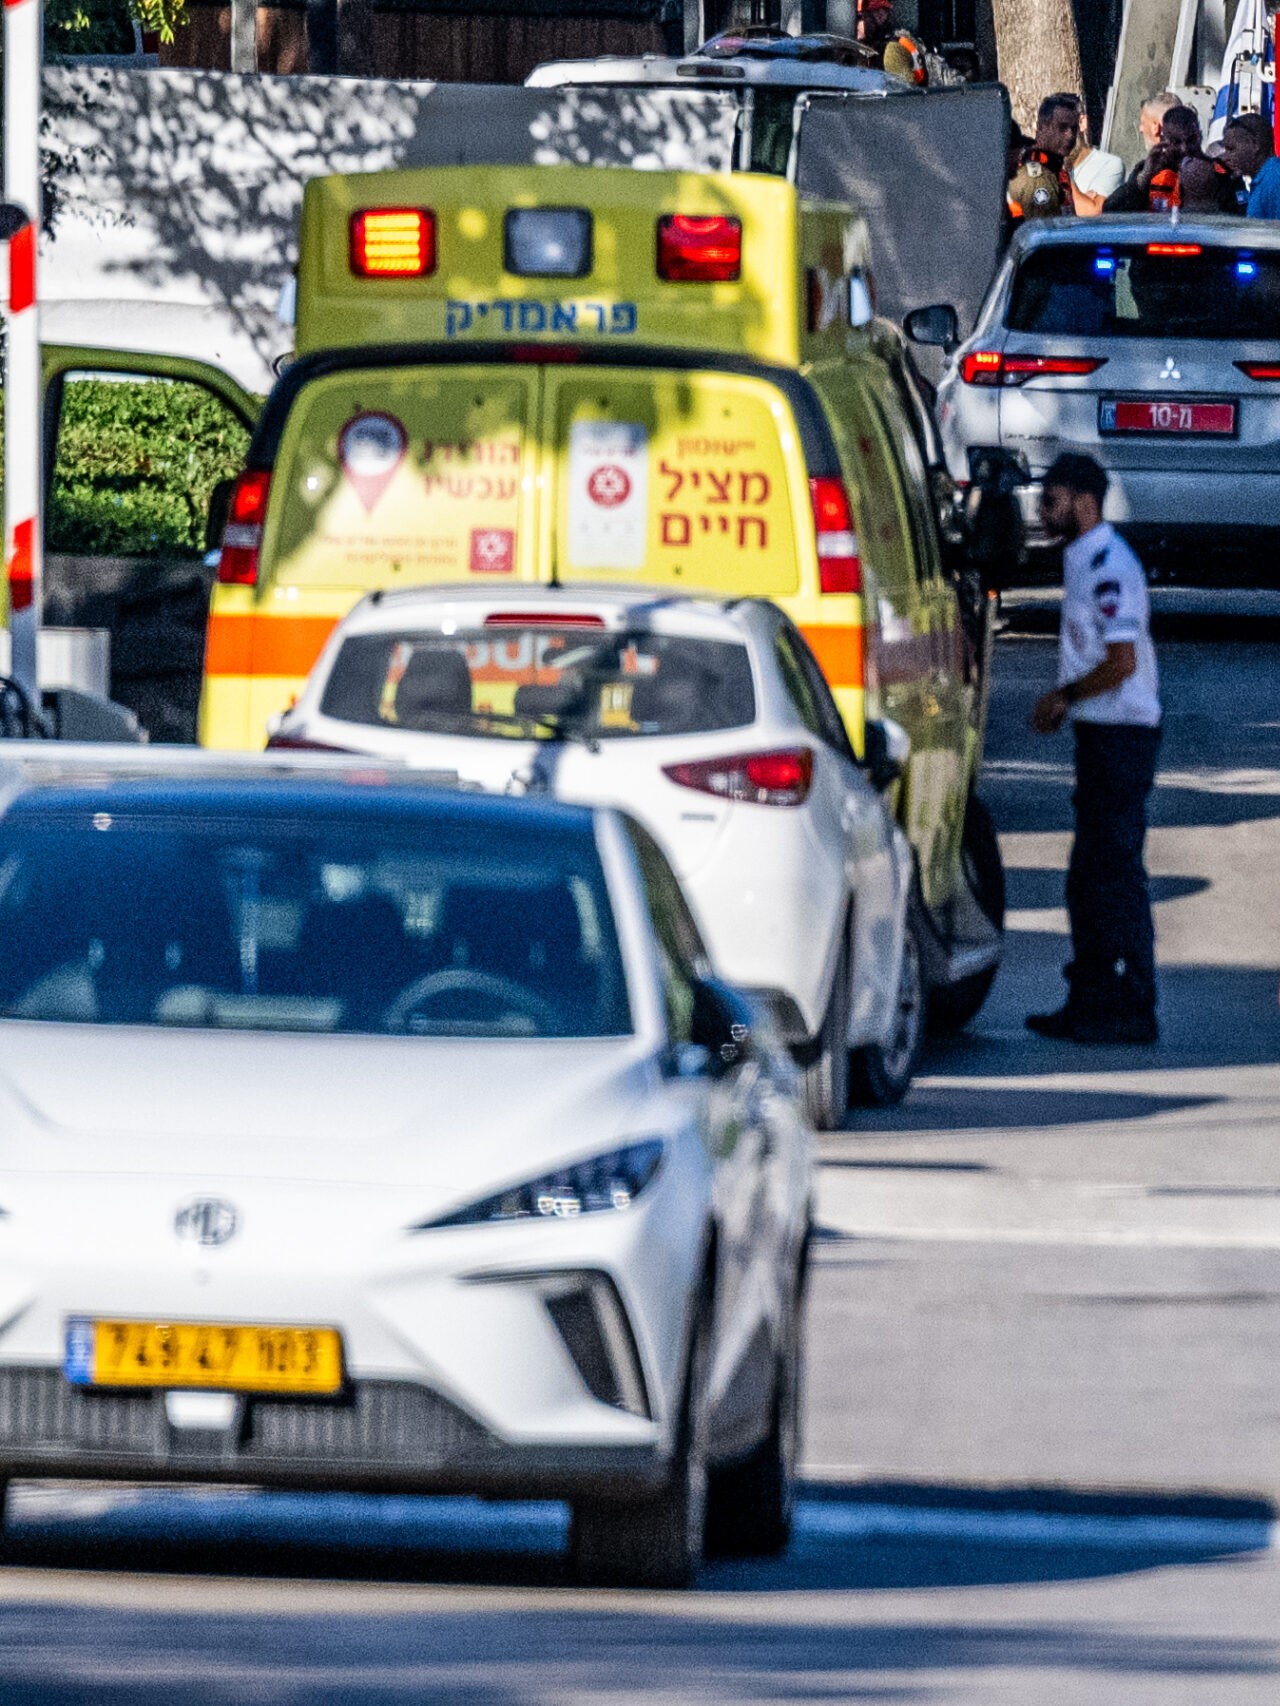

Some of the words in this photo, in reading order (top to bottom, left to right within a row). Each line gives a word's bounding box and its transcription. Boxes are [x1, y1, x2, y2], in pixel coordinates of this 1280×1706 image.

[446, 300, 637, 338] פראמדיק
[660, 460, 770, 505] מציל
[661, 513, 768, 549] חיים
